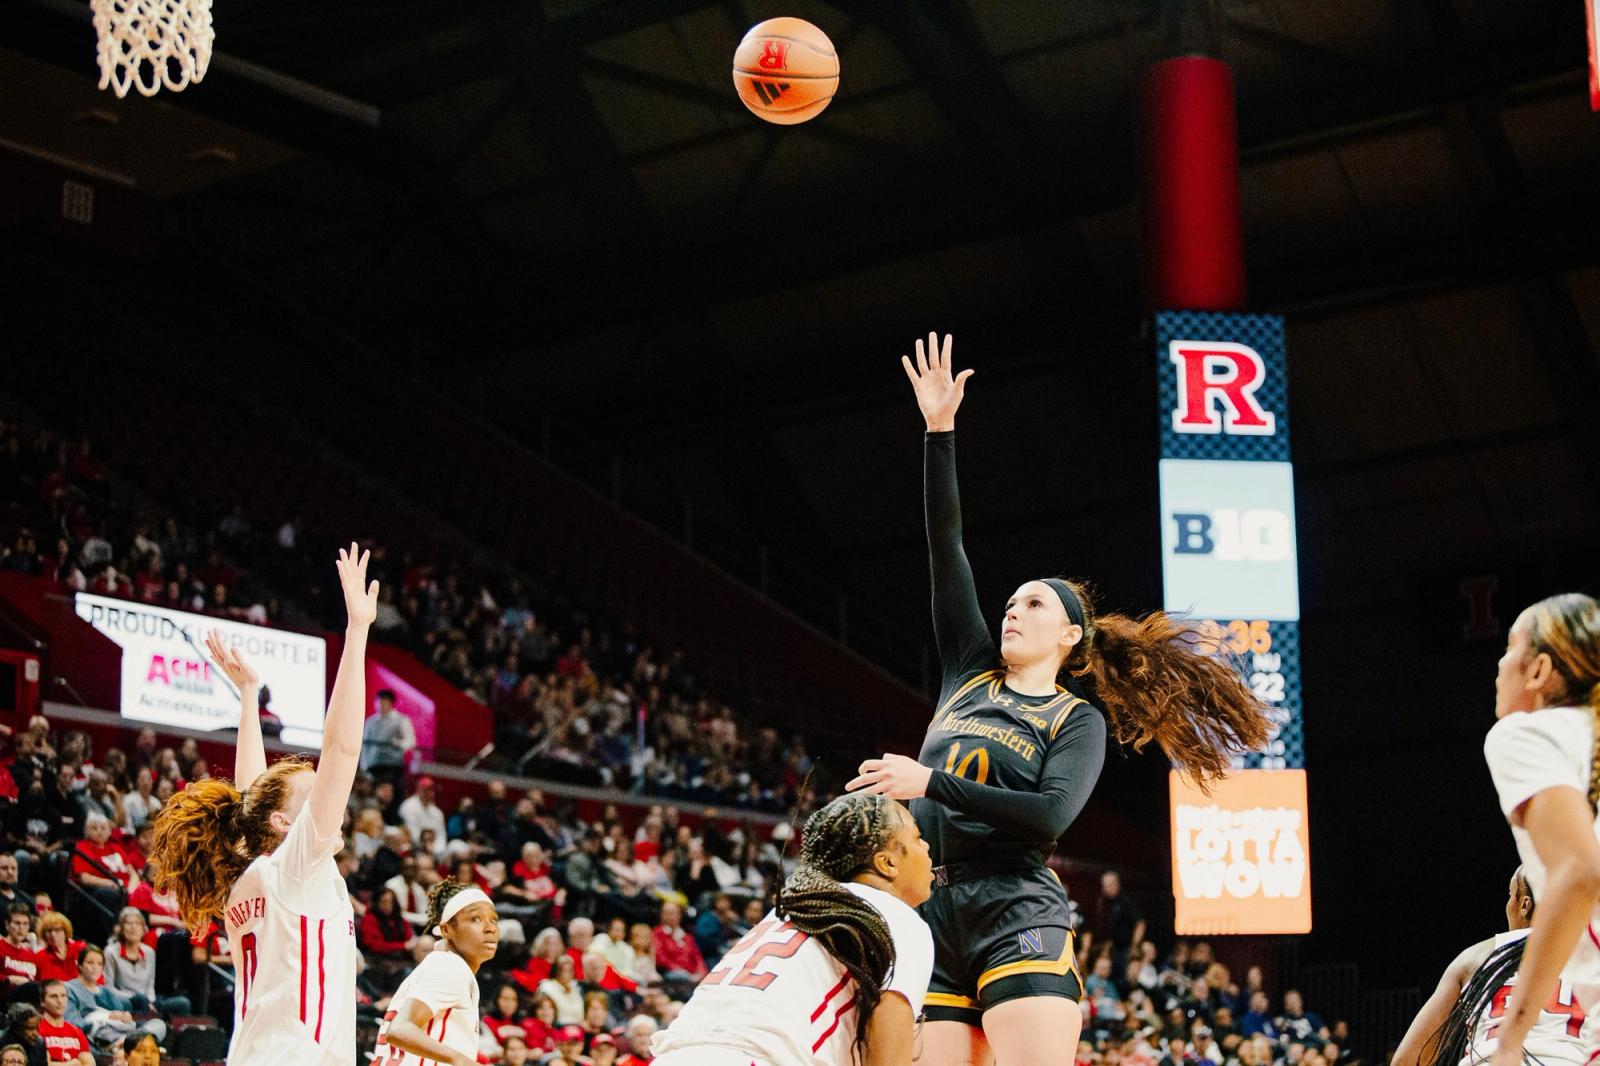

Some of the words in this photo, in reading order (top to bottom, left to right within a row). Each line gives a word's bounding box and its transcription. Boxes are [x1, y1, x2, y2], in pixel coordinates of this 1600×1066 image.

[758, 40, 790, 70] R
[1169, 339, 1276, 436] R
[91, 604, 175, 640] PROUD
[937, 710, 1036, 762] Northwestern
[944, 741, 989, 785] 10
[1178, 860, 1306, 899] WOW
[700, 920, 809, 992] 22
[1018, 928, 1044, 954] N
